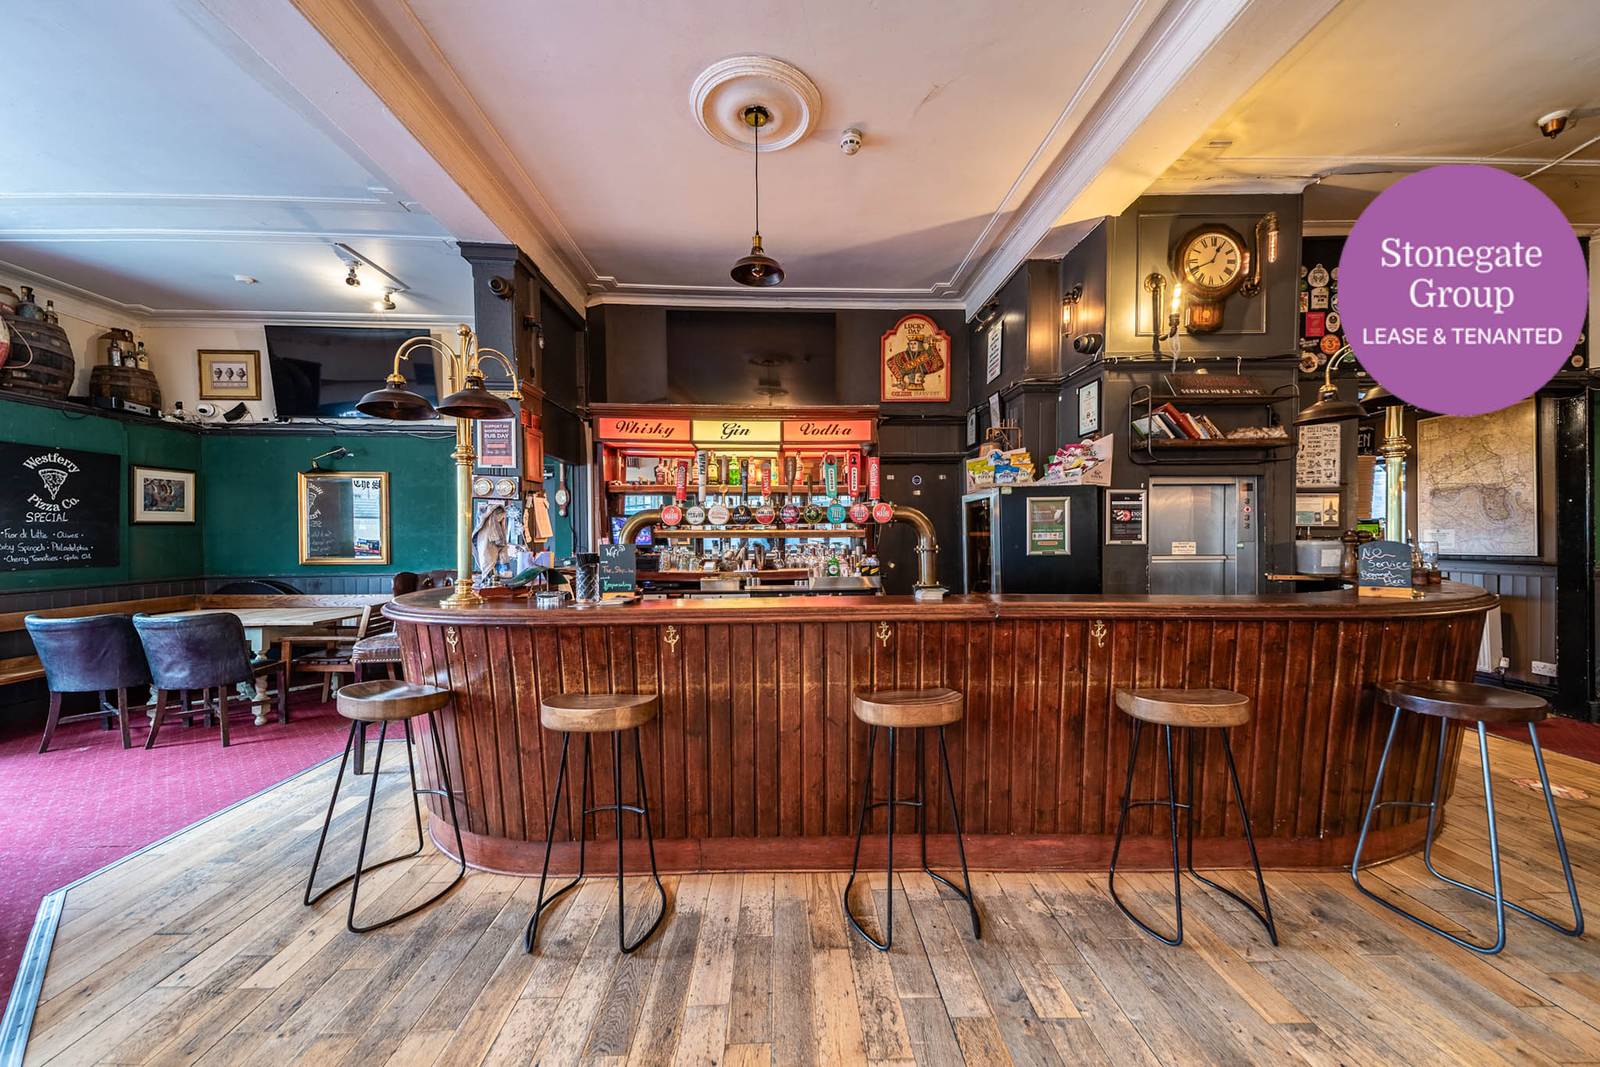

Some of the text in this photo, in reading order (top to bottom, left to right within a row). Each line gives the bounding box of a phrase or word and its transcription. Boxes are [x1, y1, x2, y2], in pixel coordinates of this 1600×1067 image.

[615, 420, 676, 438] Whisky
[721, 422, 751, 440] Gin
[799, 422, 852, 437] Vodka
[23, 453, 81, 474] Westferry
[27, 494, 80, 512] Pizza Co.
[26, 511, 69, 523] SPECIAL
[6, 555, 29, 565] Cherry
[1369, 560, 1410, 570] Service
[1384, 577, 1407, 586] Here
